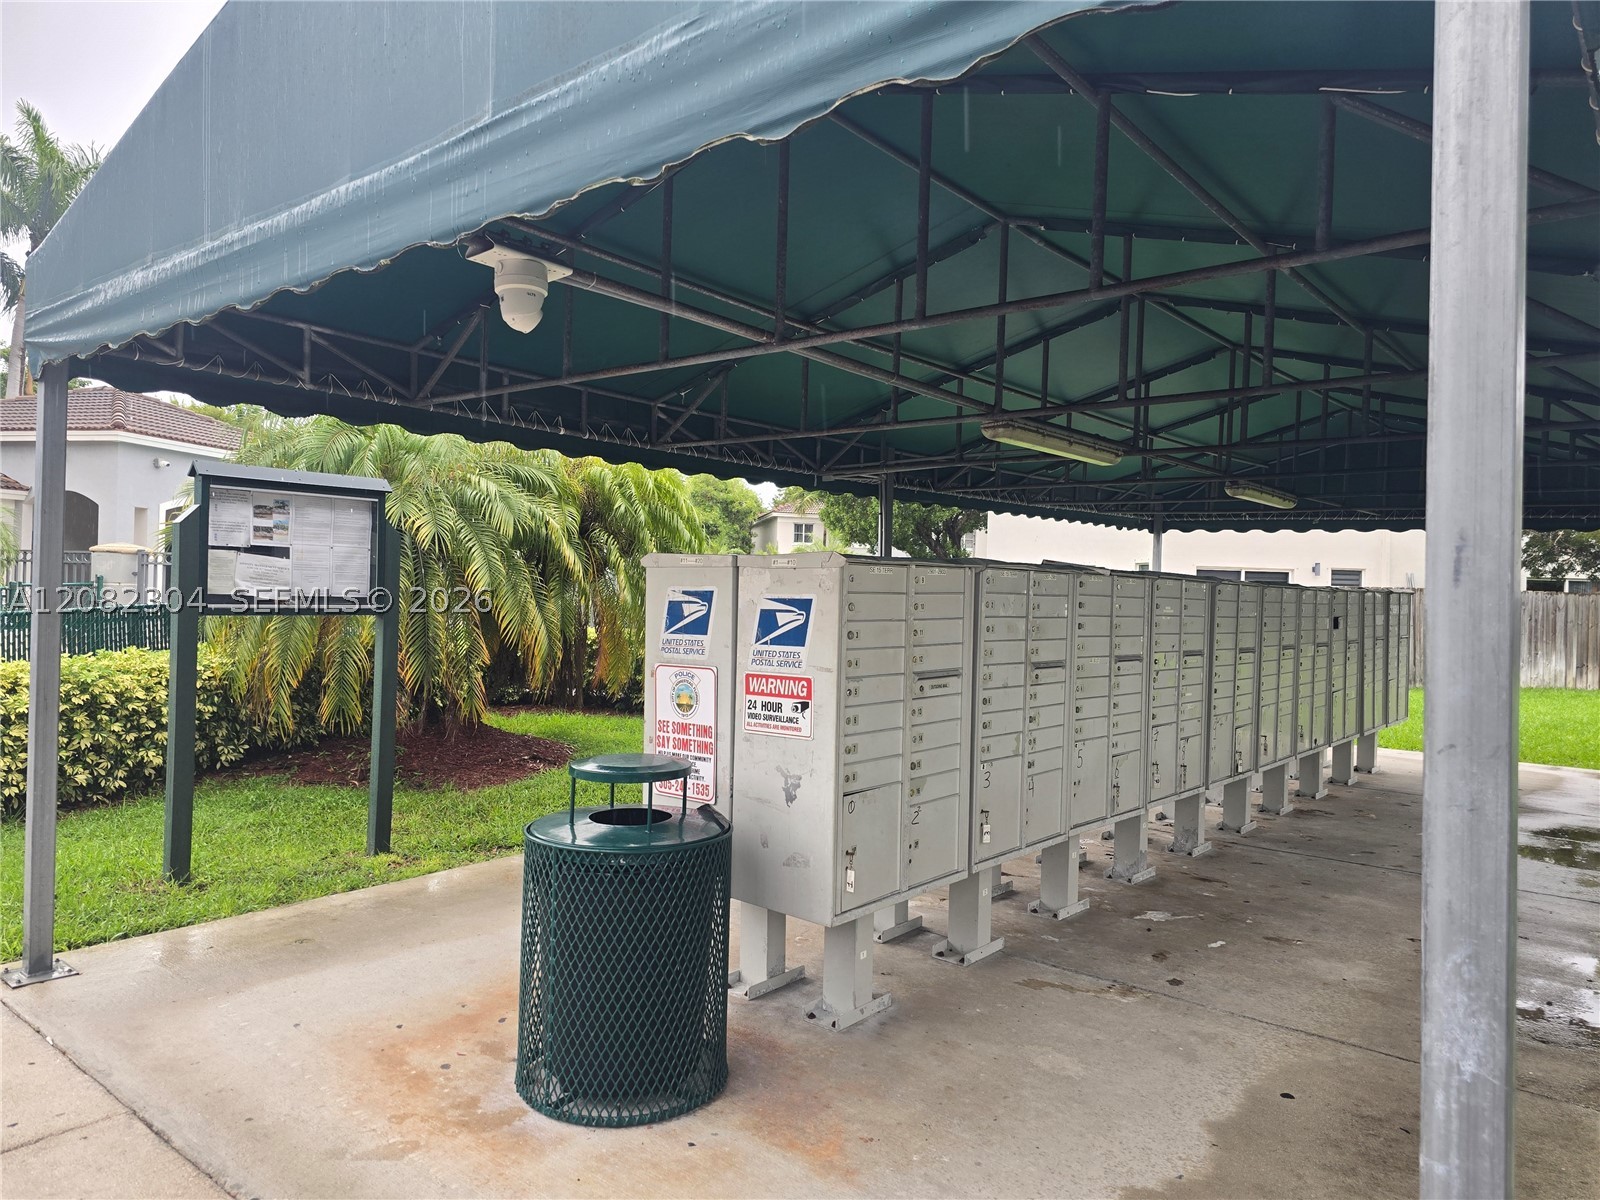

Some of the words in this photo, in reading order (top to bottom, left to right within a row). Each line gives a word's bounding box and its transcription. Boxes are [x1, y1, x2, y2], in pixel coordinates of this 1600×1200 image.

[660, 646, 682, 654] POSTAL
[682, 648, 706, 656] SERVICE
[752, 650, 778, 658] UNITED
[778, 650, 802, 659] STATES
[750, 658, 775, 667] POSTAL
[776, 660, 802, 668] SERVICE
[674, 672, 696, 680] POLICE
[748, 676, 808, 697] WARNING
[747, 700, 757, 710] 24
[761, 701, 783, 713] HOUR
[747, 712, 762, 720] VIDEO
[762, 714, 799, 724] SURVEILLANCE
[658, 720, 670, 734] SEE
[672, 721, 713, 739] SOMETHING
[656, 735, 670, 748] SAY
[672, 737, 713, 755] SOMETHING
[690, 755, 712, 763] COMMUNITY
[1076, 748, 1083, 768] 5
[984, 771, 991, 788] 3
[659, 780, 710, 797] 305-24-1535
[911, 810, 919, 825] 2
